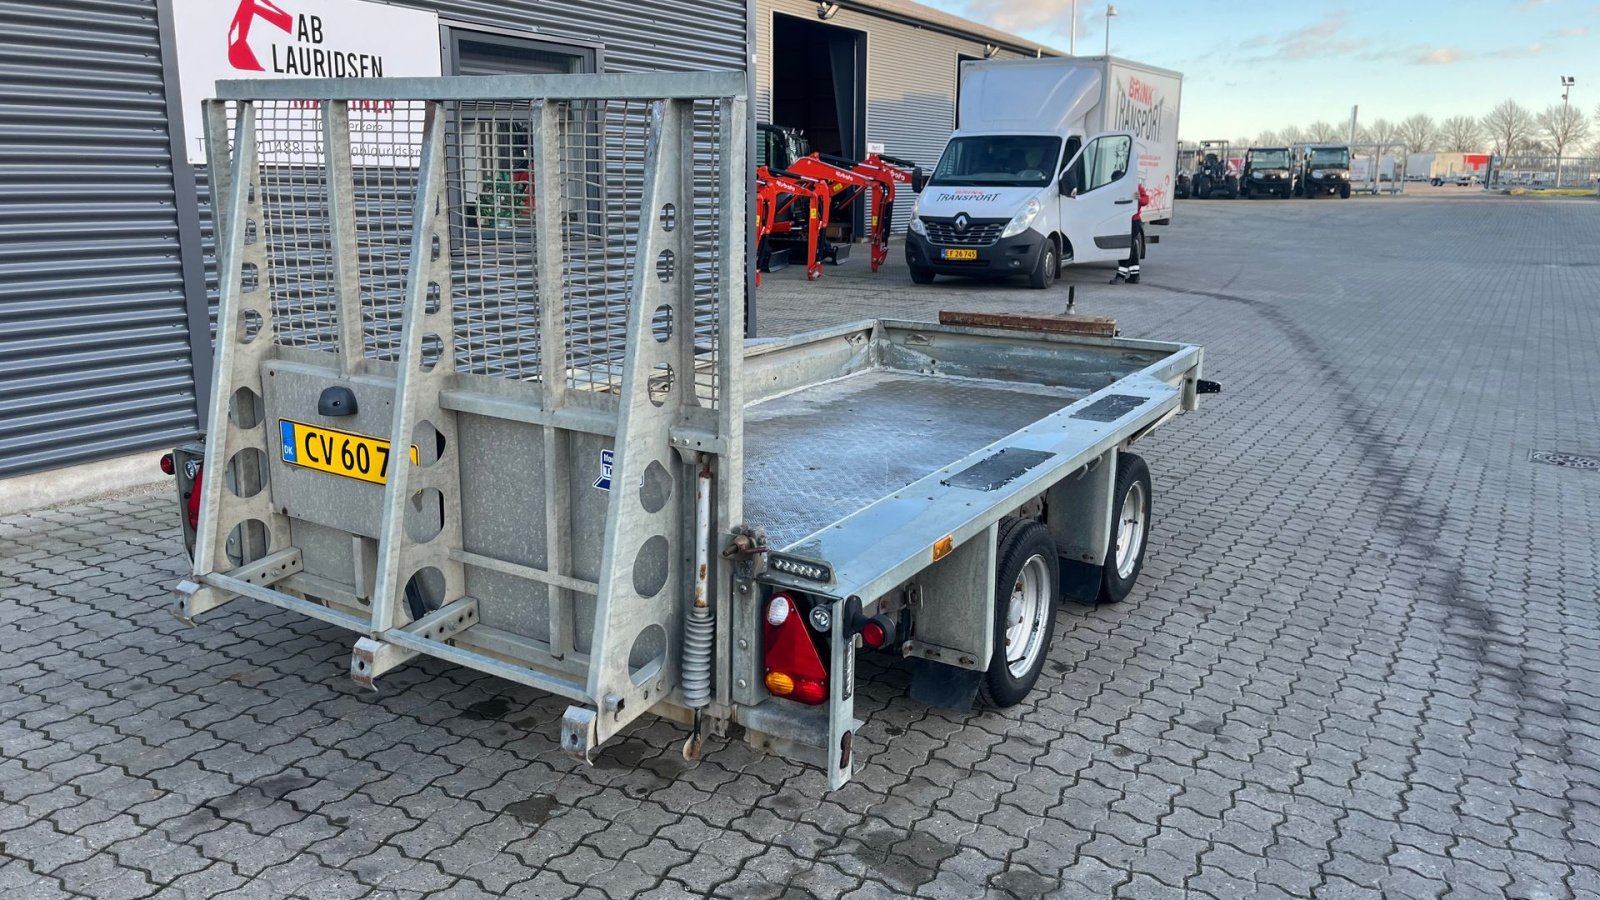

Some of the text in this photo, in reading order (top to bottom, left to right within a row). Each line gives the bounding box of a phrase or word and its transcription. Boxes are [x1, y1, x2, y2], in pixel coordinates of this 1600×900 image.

[297, 14, 323, 44] AB
[272, 44, 383, 78] LAURIDSEN
[1129, 76, 1153, 107] BRINK
[1114, 75, 1165, 143] TRANSPORT
[936, 193, 1001, 202] TRANSPORT
[284, 445, 294, 455] DK
